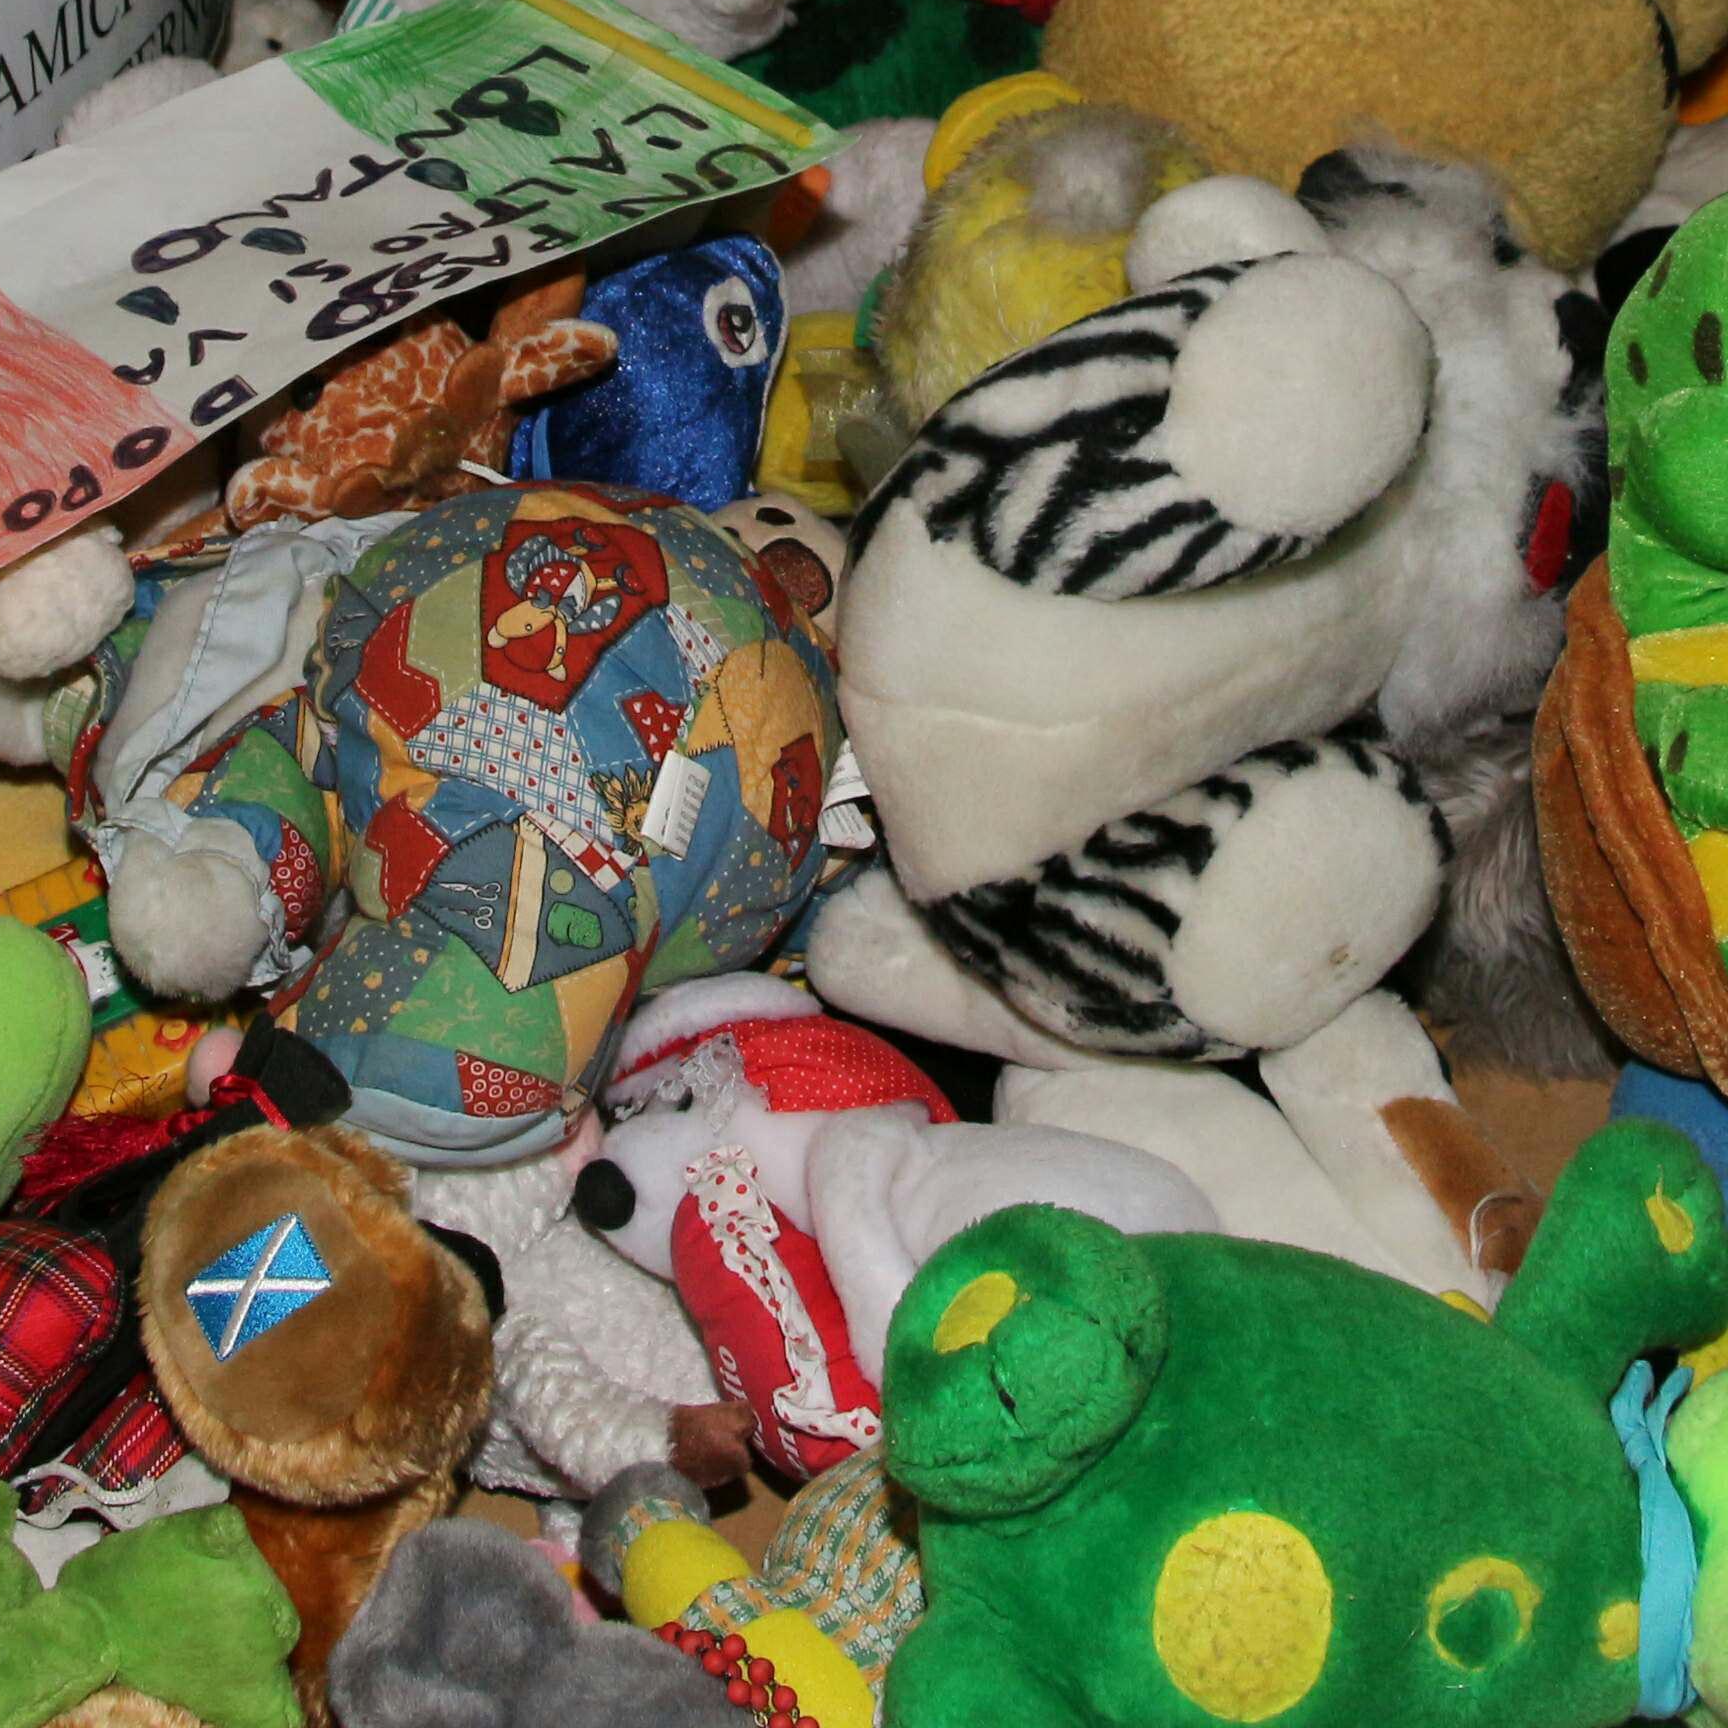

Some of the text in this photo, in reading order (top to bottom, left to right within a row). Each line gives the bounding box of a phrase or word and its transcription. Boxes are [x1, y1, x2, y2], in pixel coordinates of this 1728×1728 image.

[130, 44, 590, 274] LONTANO
[369, 102, 709, 257] L'ALTRO
[603, 142, 790, 218] UN
[112, 327, 248, 387] VA
[0, 373, 258, 534] DOPO
